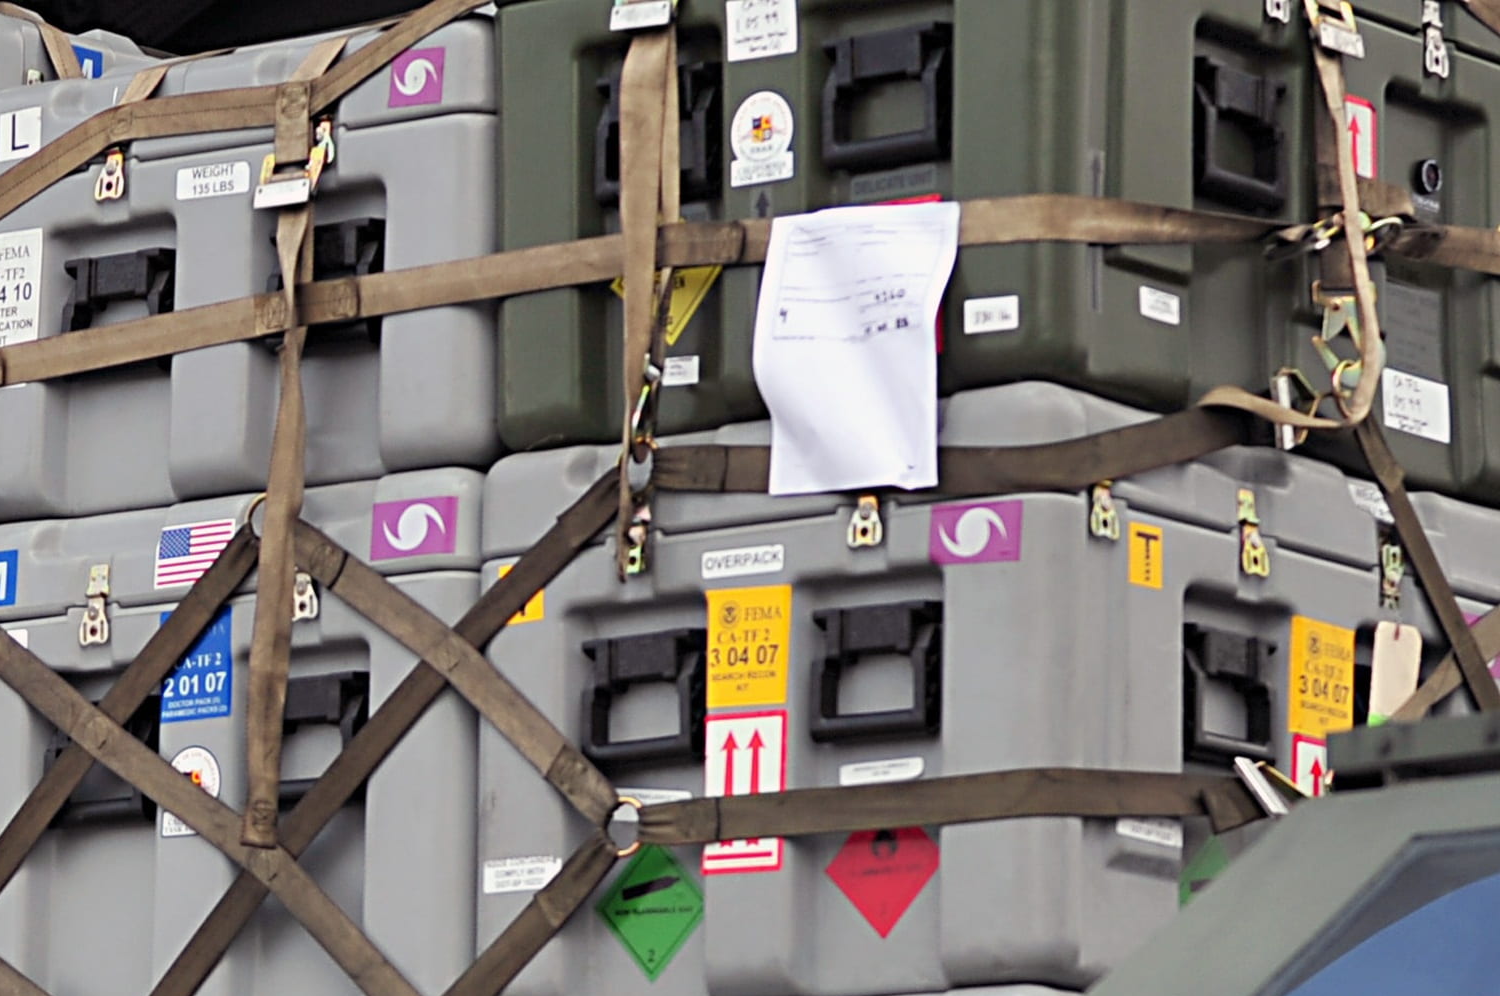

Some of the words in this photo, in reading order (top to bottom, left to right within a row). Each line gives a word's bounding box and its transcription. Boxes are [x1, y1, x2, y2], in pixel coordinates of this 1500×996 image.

[11, 113, 30, 151] L
[192, 163, 235, 179] WEIGHT
[193, 182, 210, 195] 135
[213, 180, 234, 193] LBS
[14, 282, 32, 302] 10
[704, 549, 782, 571] OVERPACK
[744, 606, 782, 622] FEMA
[176, 653, 212, 671] A-TF
[710, 648, 720, 668] 3
[727, 646, 749, 666] 04
[756, 644, 779, 665] 07
[163, 678, 174, 698] 2
[179, 675, 199, 696] 01
[204, 671, 227, 694] 07
[1299, 675, 1308, 694] 3
[1313, 678, 1329, 699] 04
[1333, 683, 1350, 704] 07
